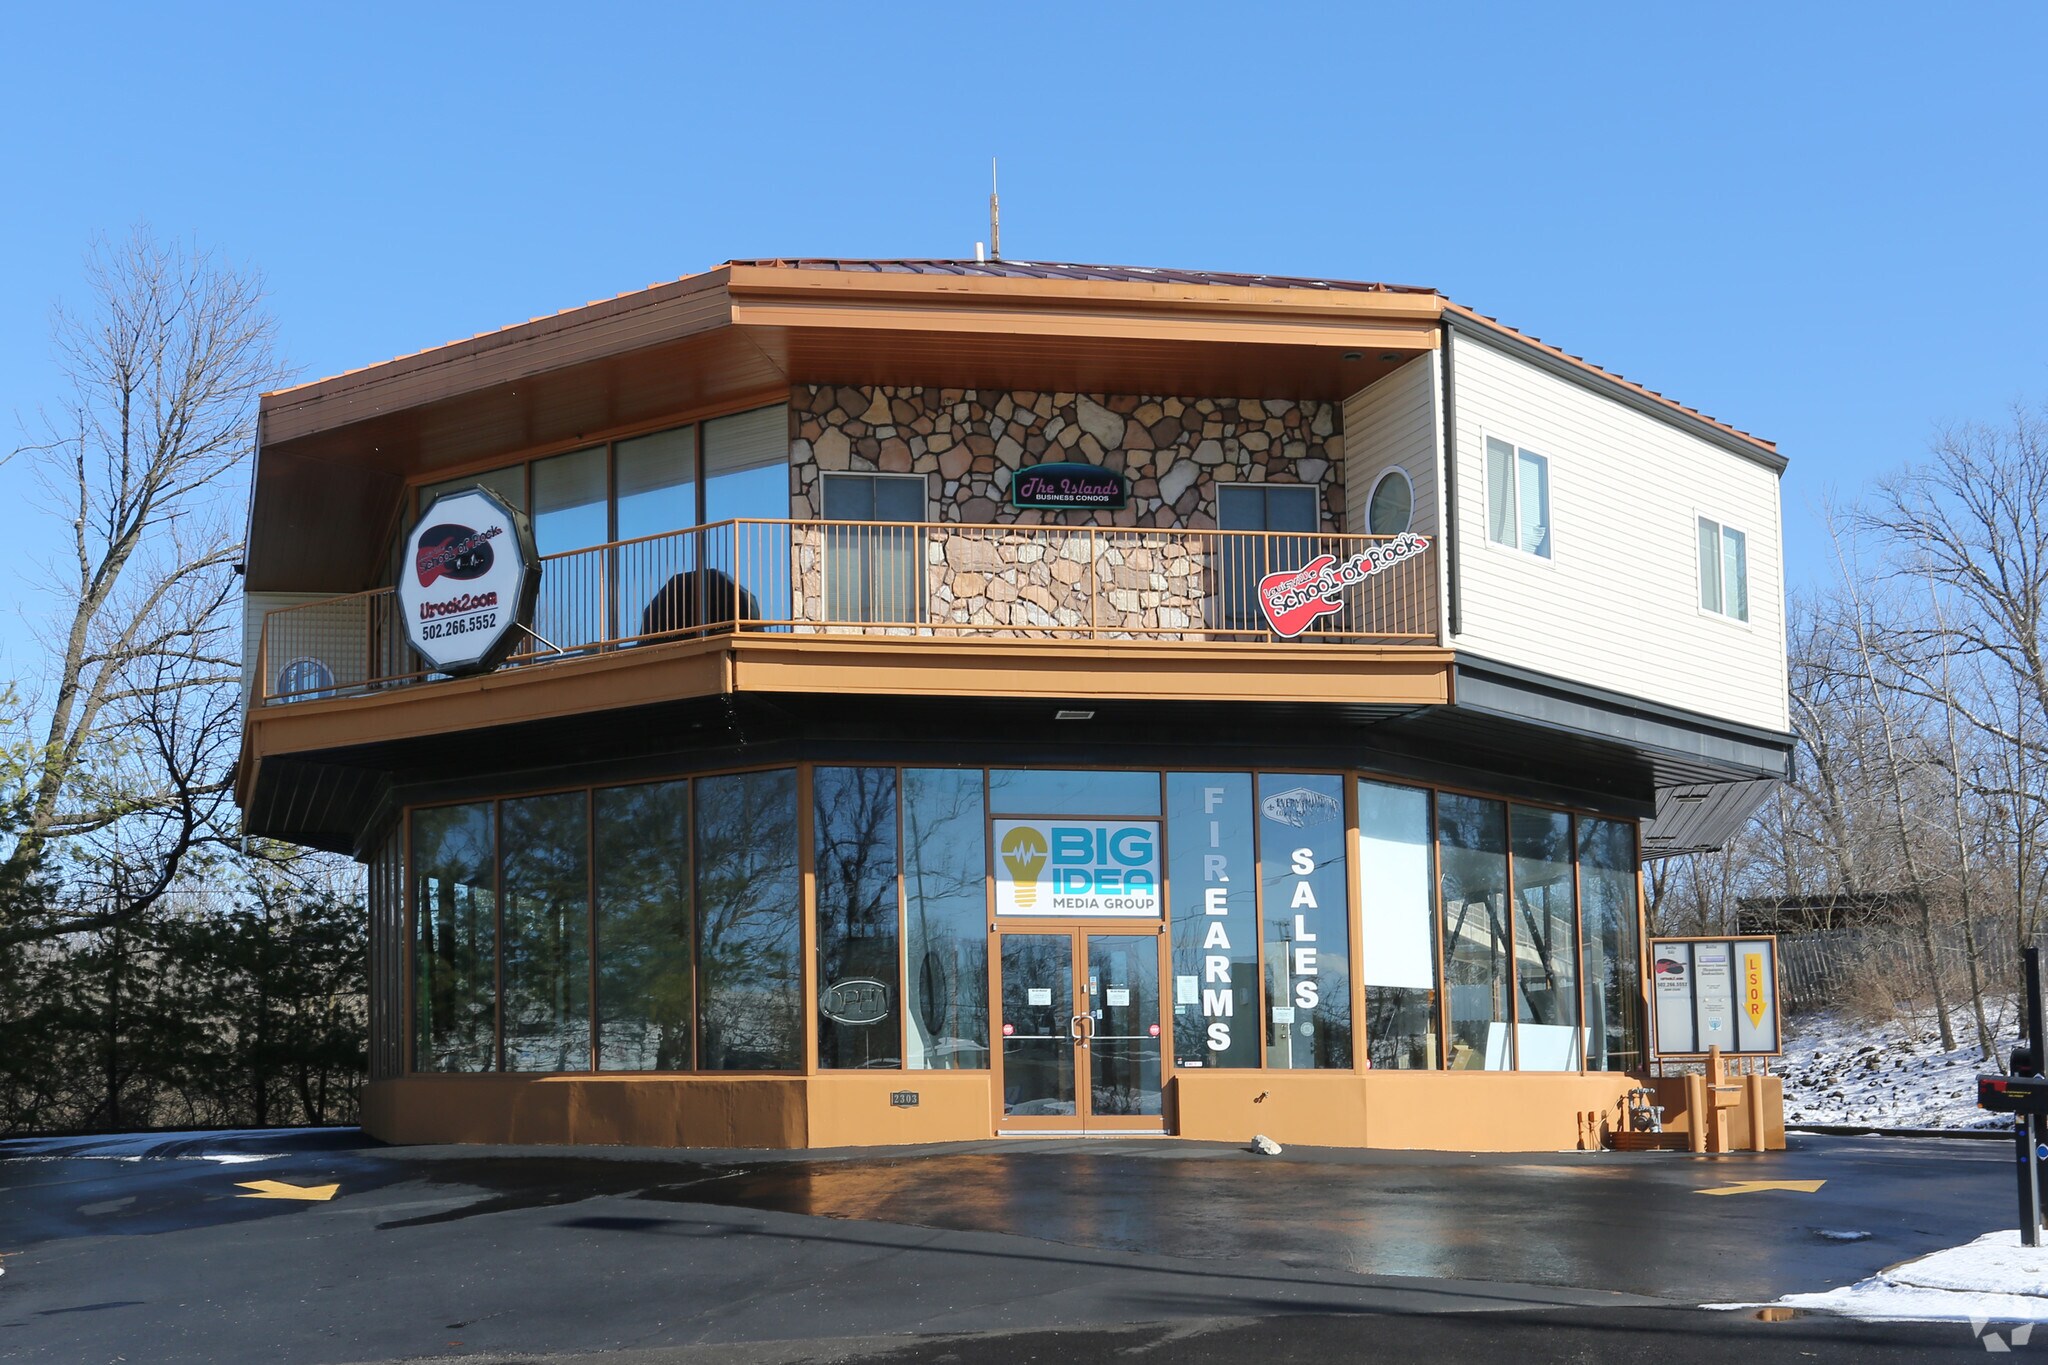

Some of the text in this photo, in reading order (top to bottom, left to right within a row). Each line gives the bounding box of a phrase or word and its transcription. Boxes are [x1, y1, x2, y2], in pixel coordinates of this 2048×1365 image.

[1021, 478, 1118, 497] The Islands
[1264, 569, 1317, 599] Louisville
[1270, 571, 1341, 616] School
[1368, 535, 1421, 571] Rock
[422, 613, 497, 641] 502.266.5552
[1051, 827, 1153, 866] BIG
[1053, 868, 1154, 895] IDEA
[1053, 898, 1154, 909] MEDIA GROUP
[1203, 787, 1234, 1051] FIREARMS
[1290, 847, 1319, 1009] SALES
[894, 1095, 917, 1103] 2303
